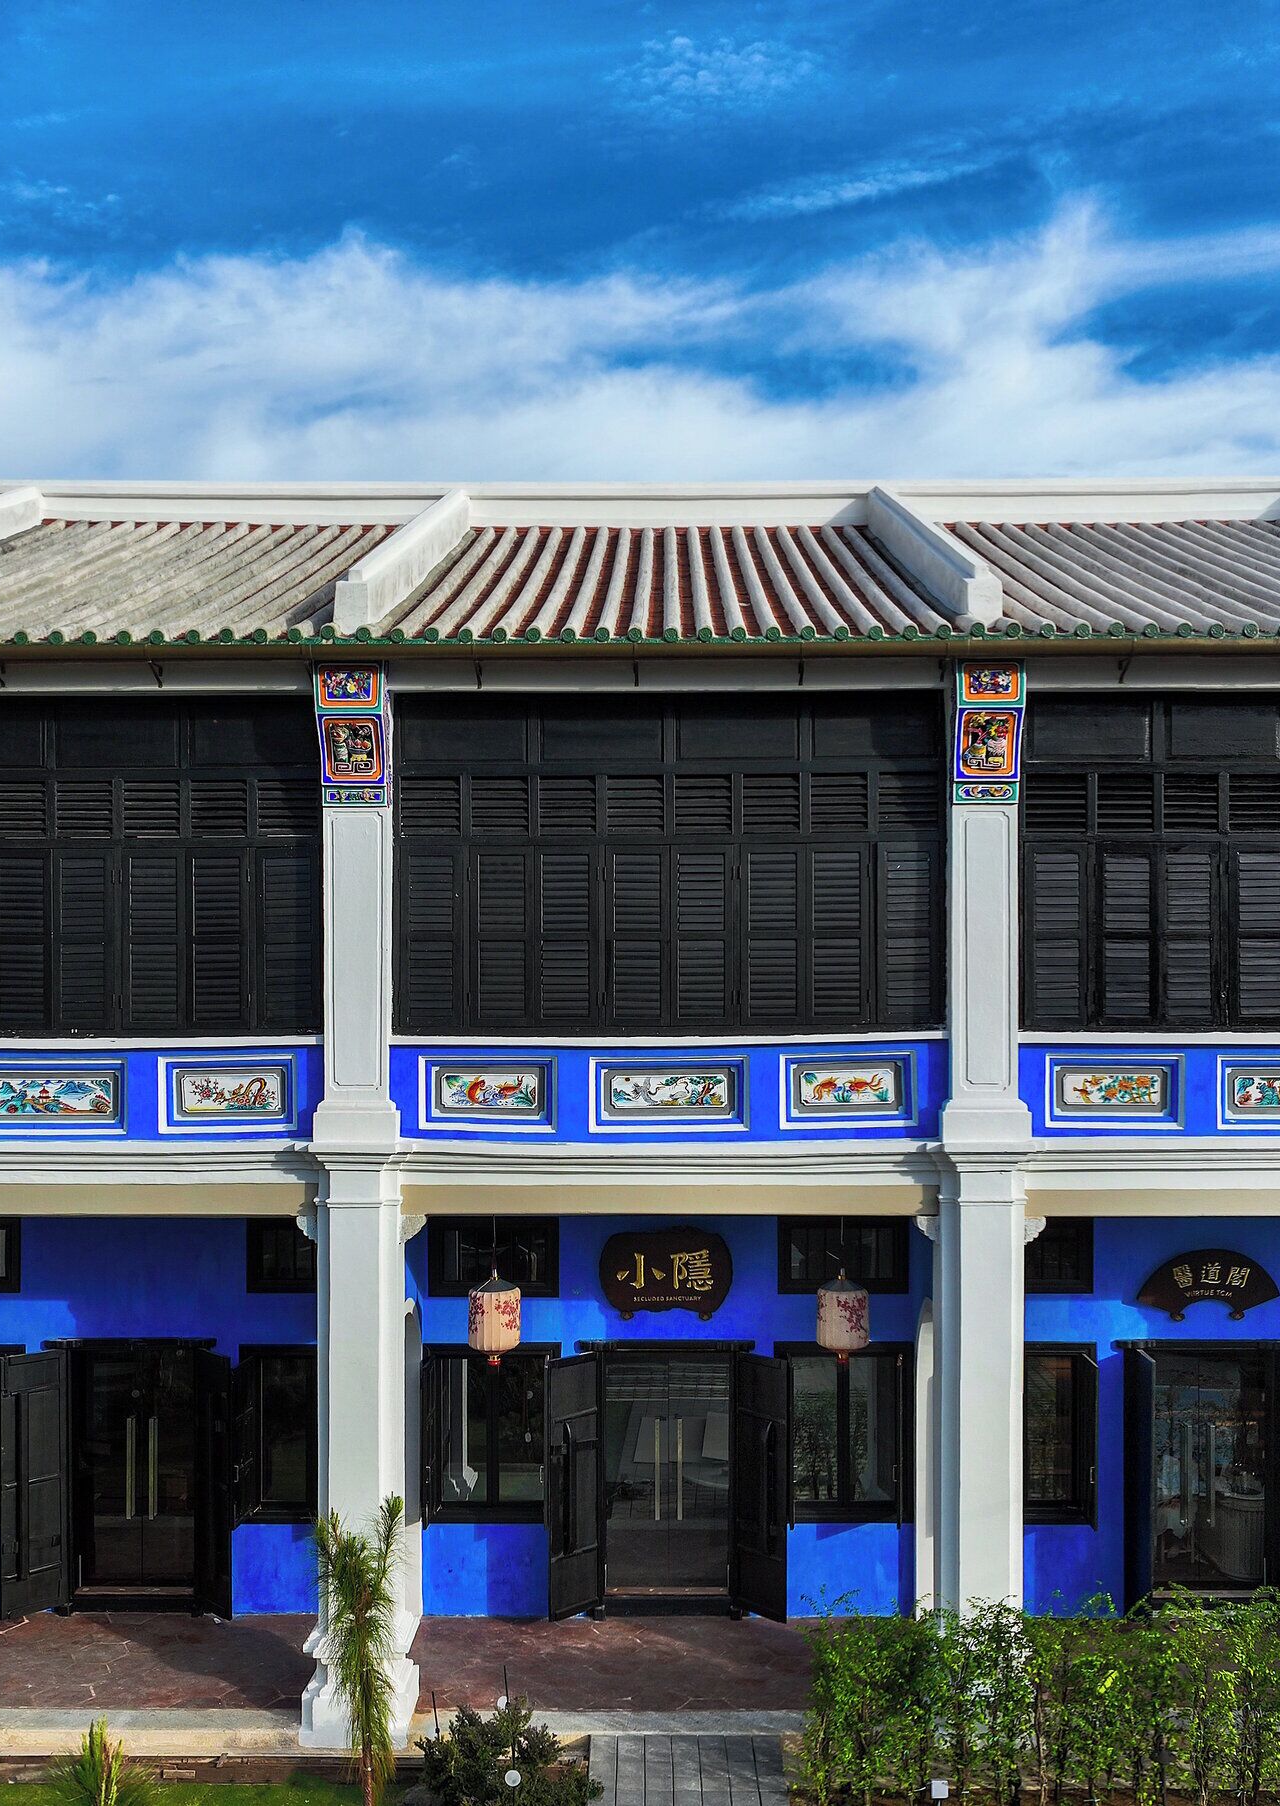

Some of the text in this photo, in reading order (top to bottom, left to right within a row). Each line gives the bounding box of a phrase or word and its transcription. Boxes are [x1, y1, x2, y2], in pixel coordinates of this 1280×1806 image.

[616, 1248, 714, 1292] 小隱
[1172, 1262, 1251, 1289] 醫道閣
[1184, 1289, 1233, 1298] VIRTUE TCM
